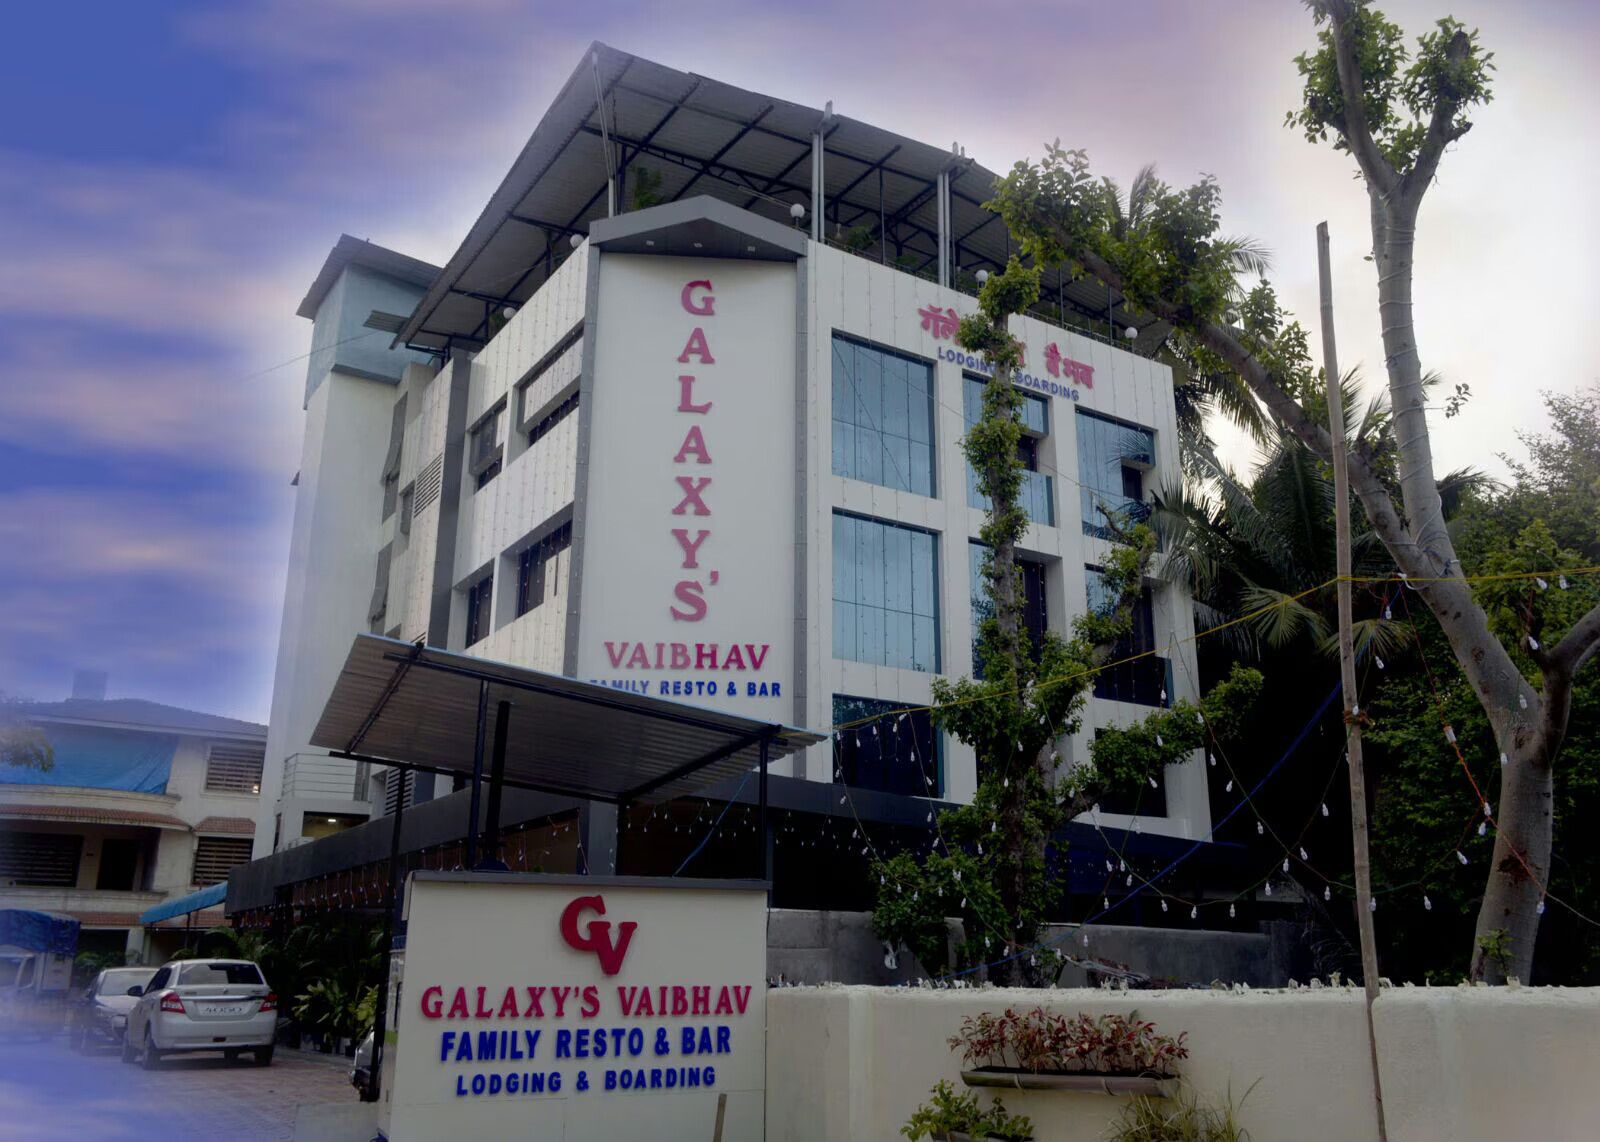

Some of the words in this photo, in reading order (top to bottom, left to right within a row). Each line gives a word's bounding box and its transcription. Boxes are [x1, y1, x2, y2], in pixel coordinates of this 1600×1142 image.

[1015, 368, 1080, 402] BOARDING
[669, 279, 720, 622] GALAXY'S
[604, 641, 770, 671] VAIBHAV
[590, 679, 650, 694] MILY
[660, 680, 717, 696] RESTO
[726, 681, 737, 697] &
[747, 681, 781, 698] BAR
[421, 985, 600, 1020] GALAXY'S
[617, 985, 752, 1017] VAIBHAV
[440, 1029, 542, 1062] FAMILY
[555, 1027, 645, 1058] RESTO
[653, 1026, 671, 1056] &
[681, 1025, 731, 1055] BAR
[456, 1070, 562, 1097] LODGING
[576, 1070, 590, 1091] &
[604, 1066, 716, 1091] BOARDING
